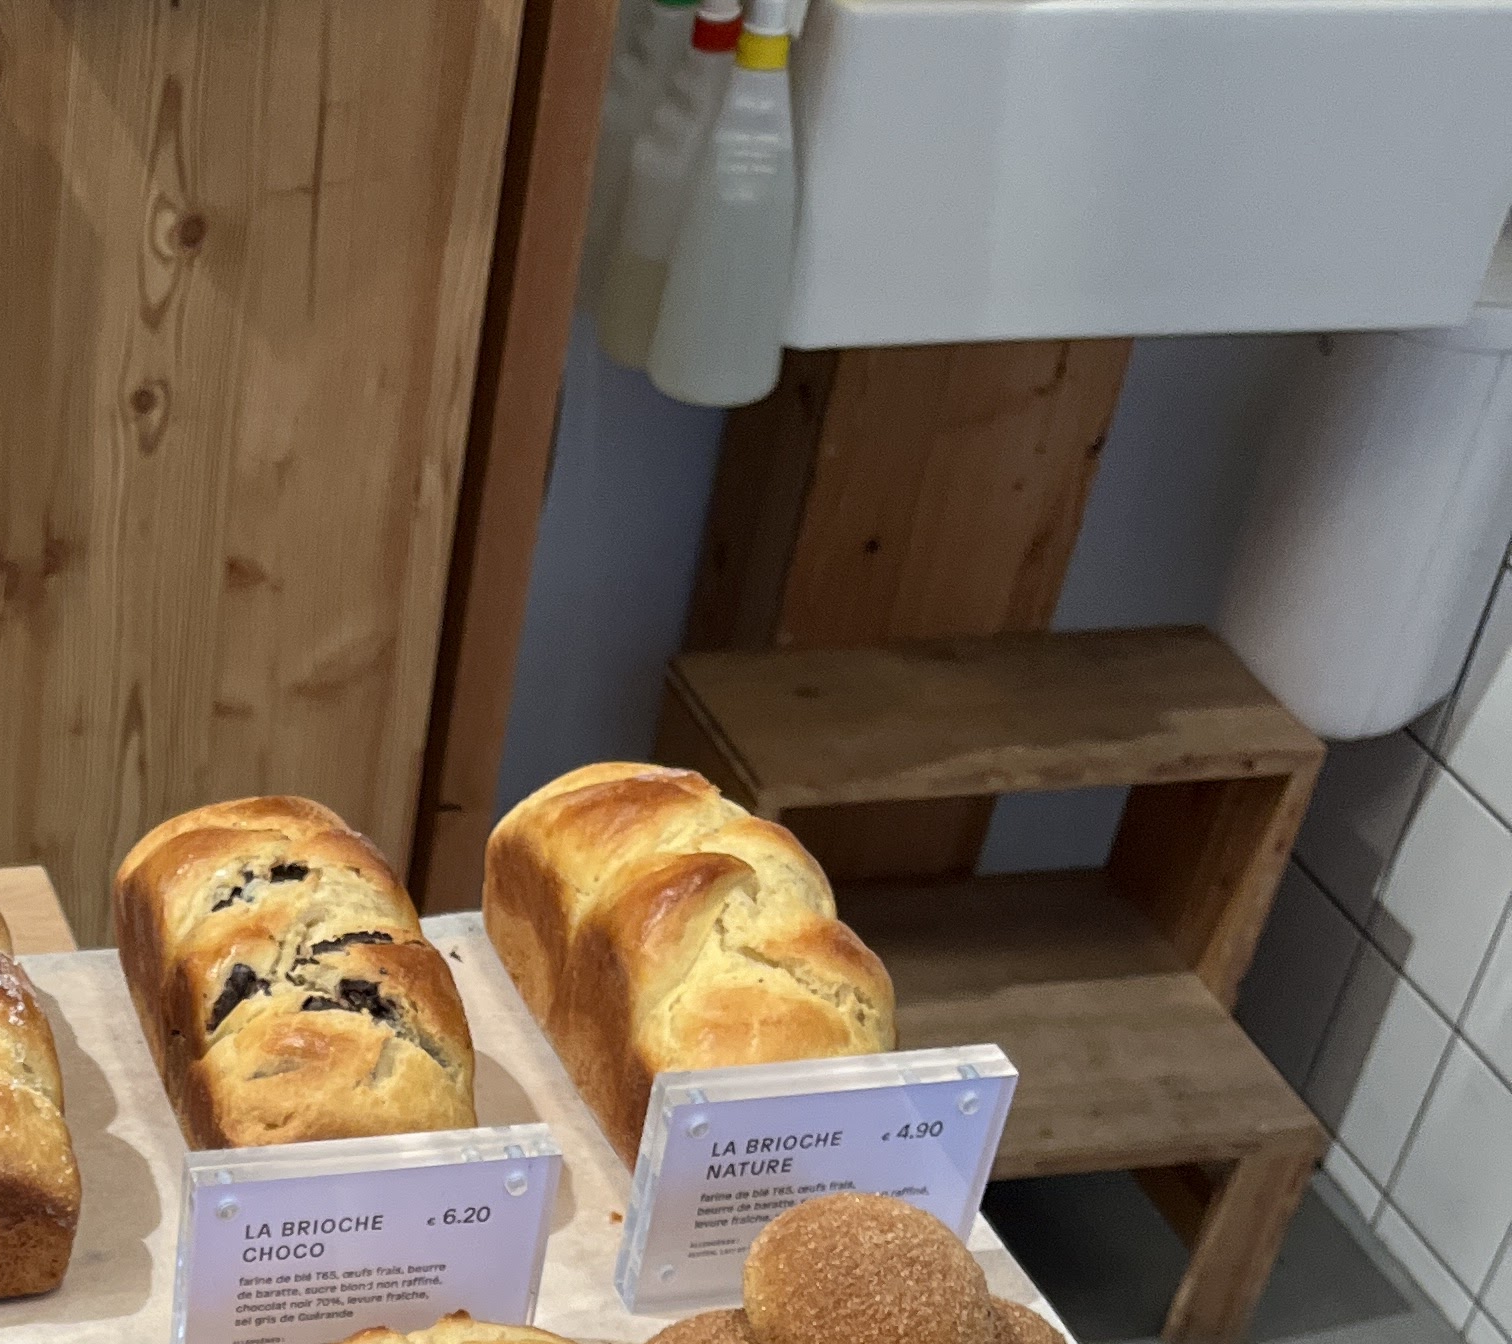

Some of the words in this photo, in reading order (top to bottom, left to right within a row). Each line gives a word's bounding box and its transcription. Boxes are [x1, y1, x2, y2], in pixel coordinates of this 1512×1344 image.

[711, 1140, 737, 1158] LA
[746, 1131, 844, 1154] BRIOCHE
[897, 1120, 944, 1140] 4.90
[706, 1157, 794, 1180] NATURE
[244, 1223, 272, 1240] LA
[281, 1214, 385, 1238] BRIOCHE
[426, 1217, 436, 1227] €
[442, 1206, 492, 1225] 6.20
[242, 1242, 326, 1264] CHOCO
